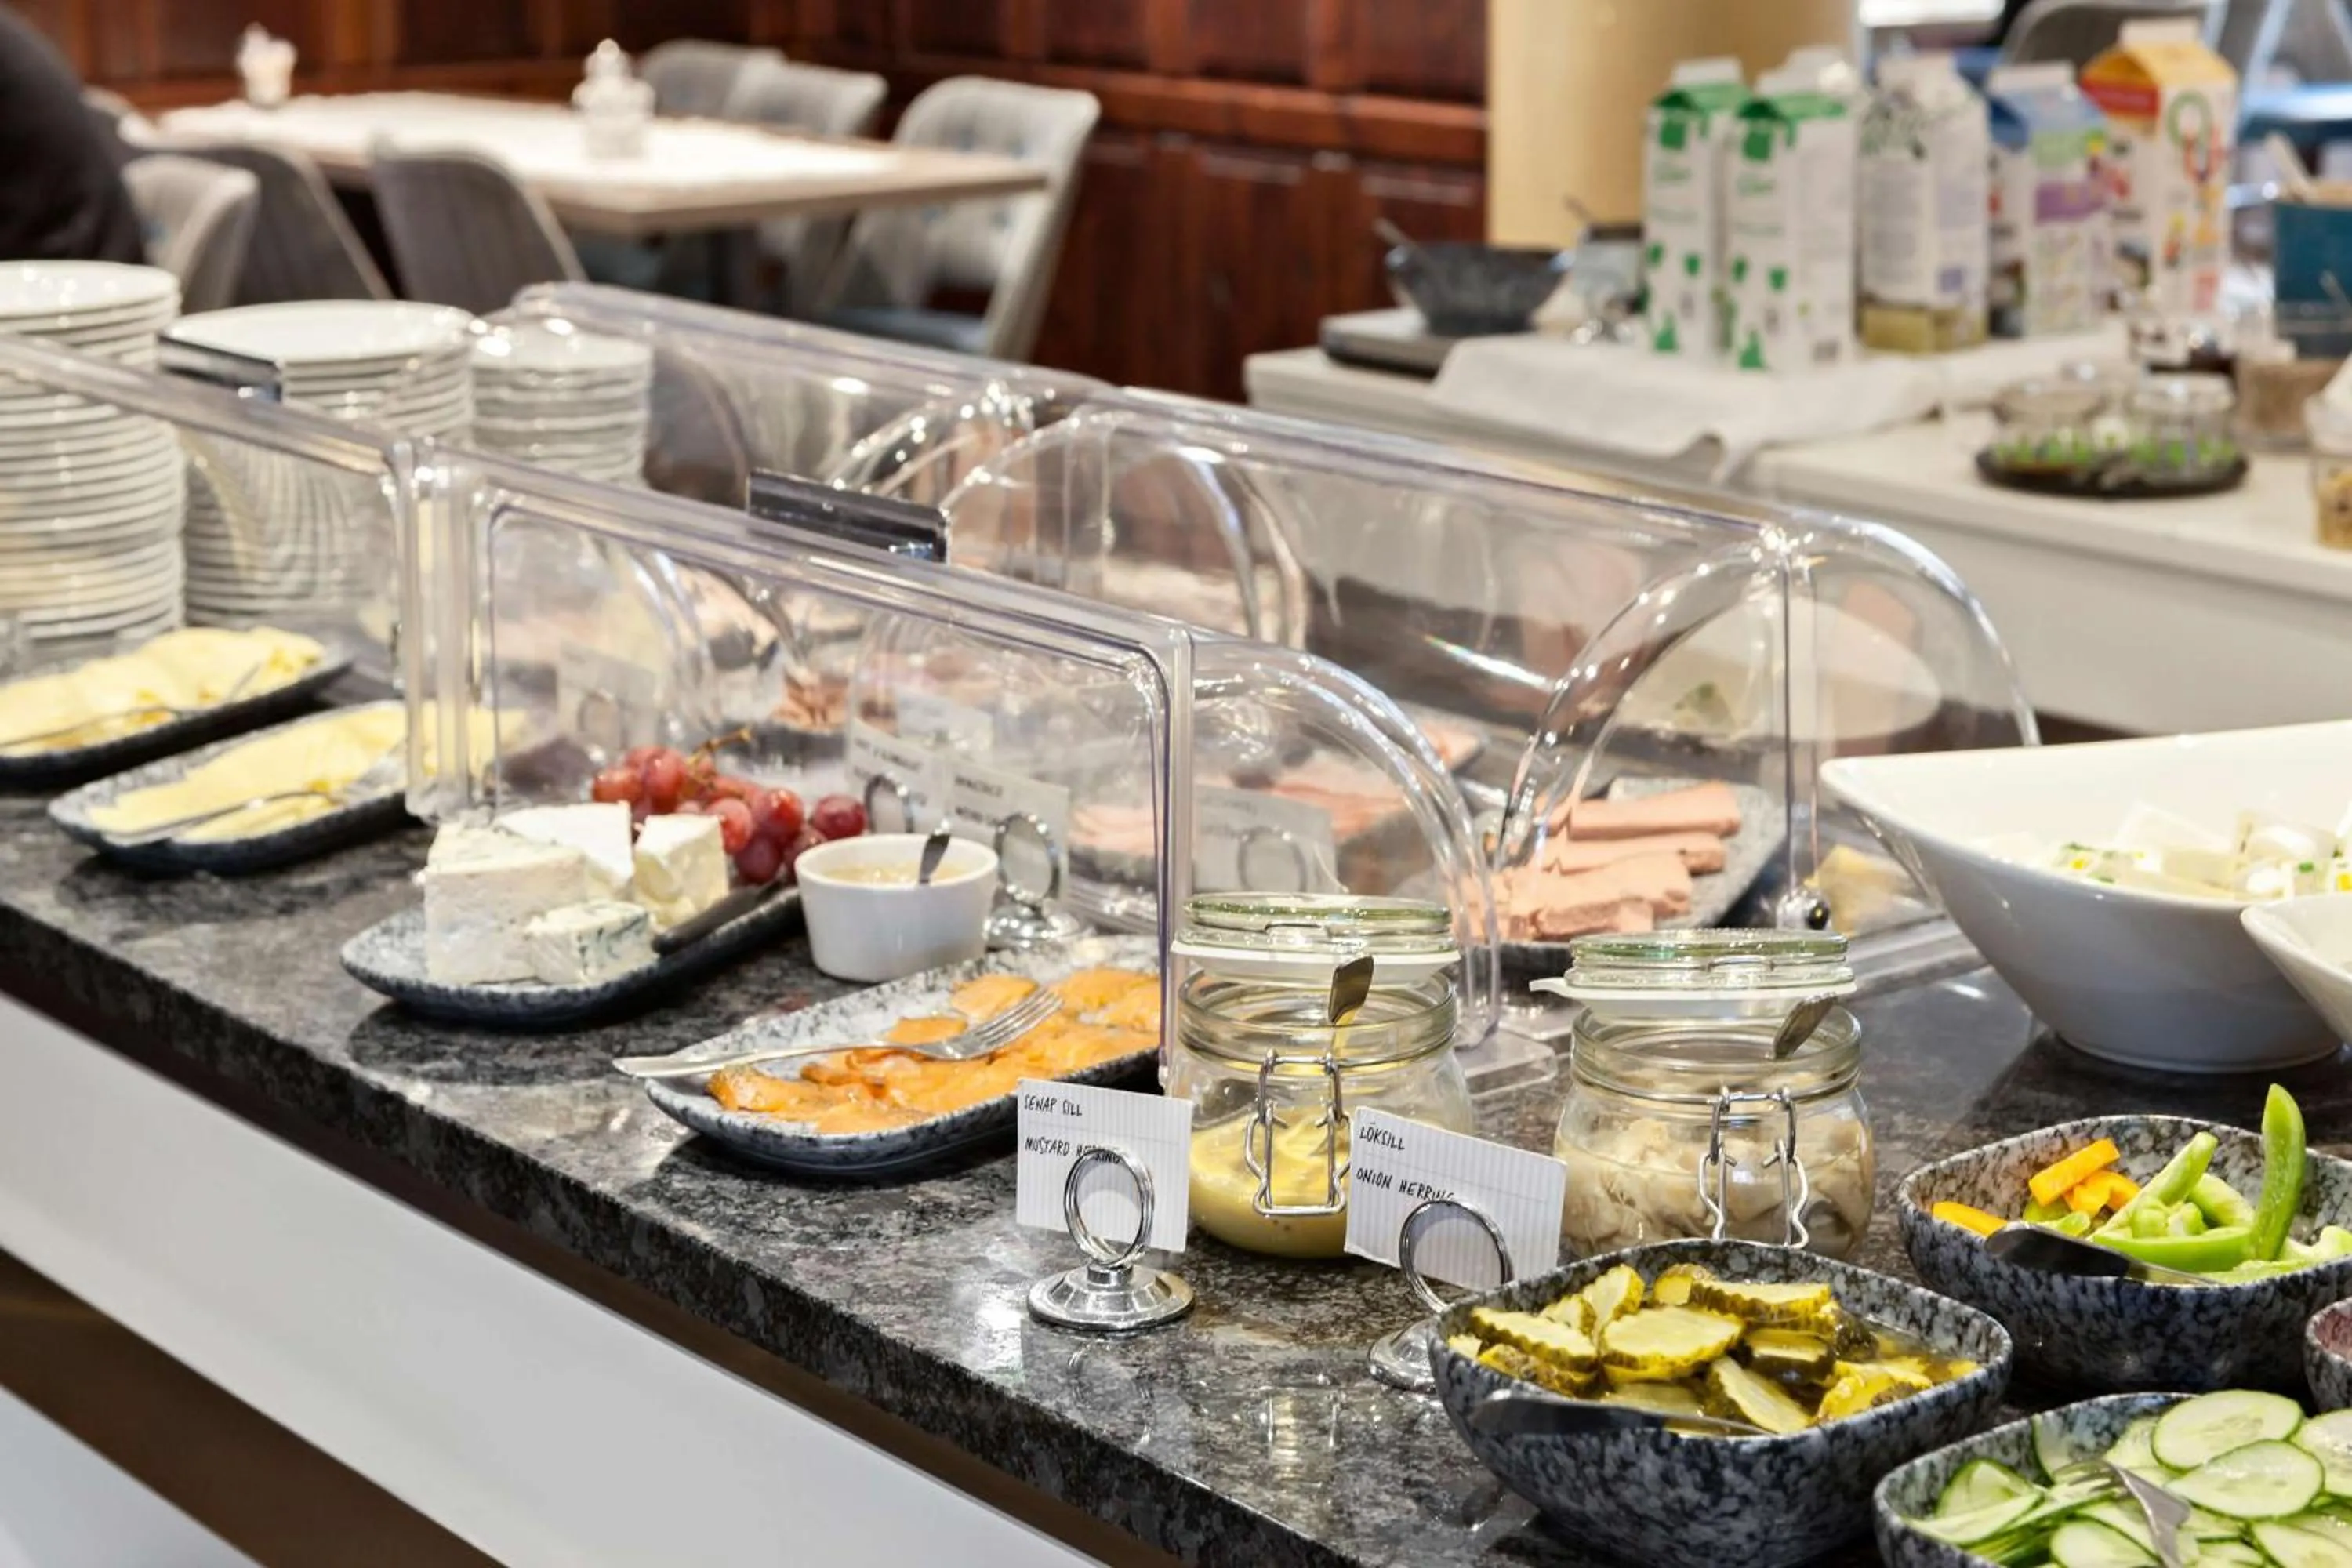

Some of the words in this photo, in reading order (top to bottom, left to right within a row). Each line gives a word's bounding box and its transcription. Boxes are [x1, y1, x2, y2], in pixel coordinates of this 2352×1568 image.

[1024, 1094, 1058, 1113] SENAP
[1062, 1099, 1083, 1117] SILL
[1025, 1136, 1070, 1156] MUSTARD
[1356, 1167, 1393, 1190] ONION
